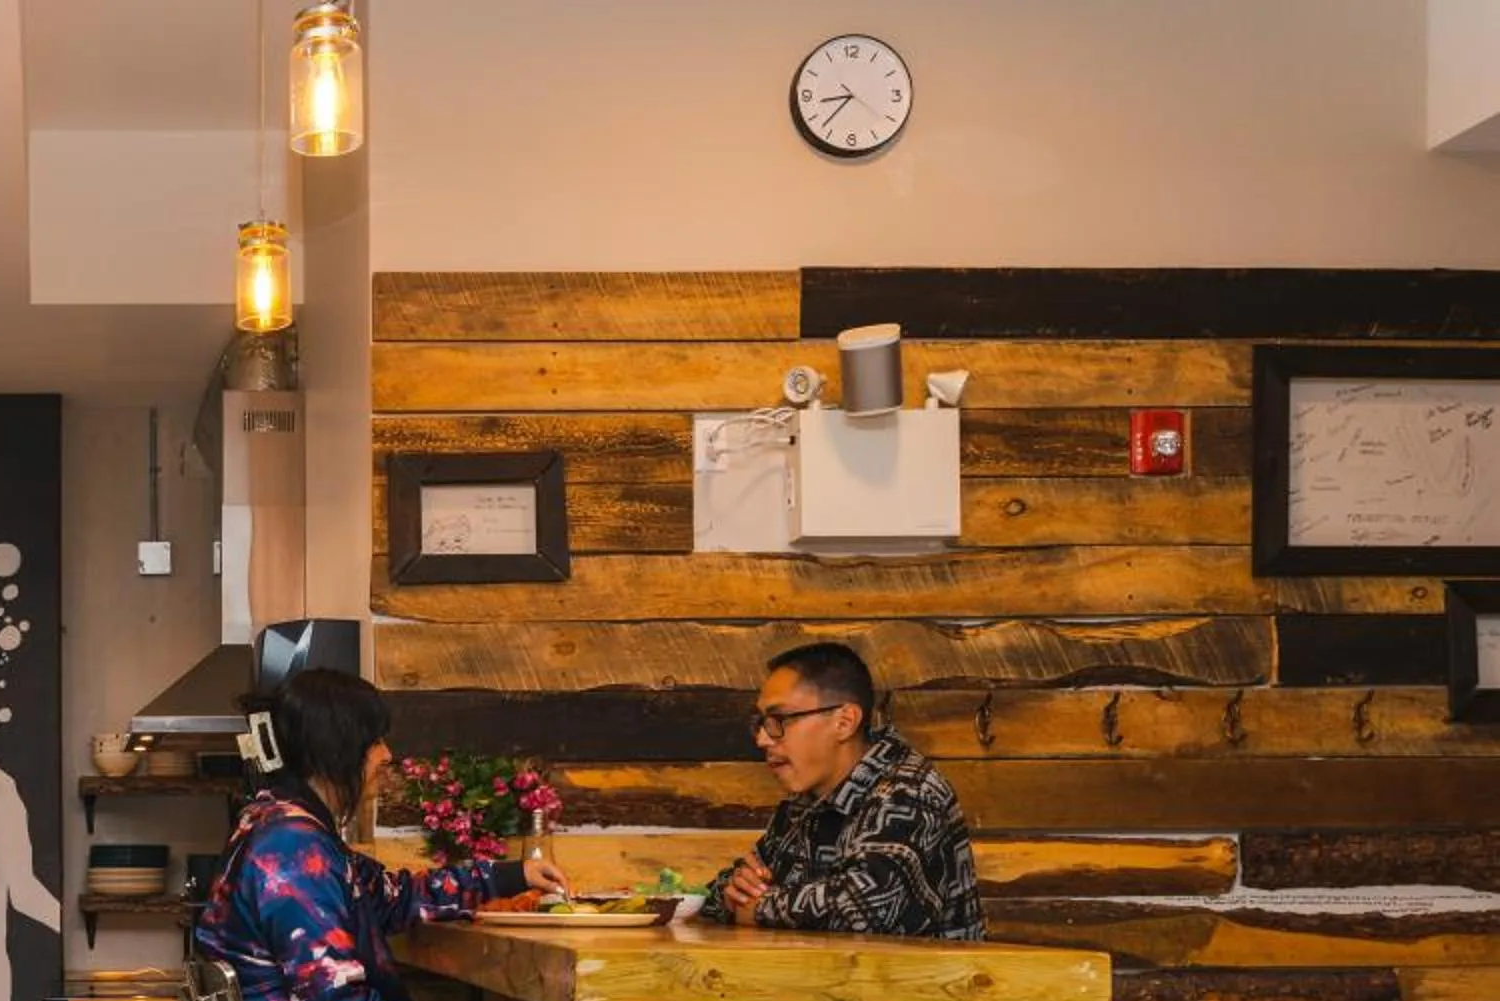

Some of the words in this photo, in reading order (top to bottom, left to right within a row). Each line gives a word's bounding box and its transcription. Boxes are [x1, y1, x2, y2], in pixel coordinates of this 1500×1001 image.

[844, 45, 860, 59] 12
[801, 89, 813, 103] 9
[891, 89, 902, 102] 3
